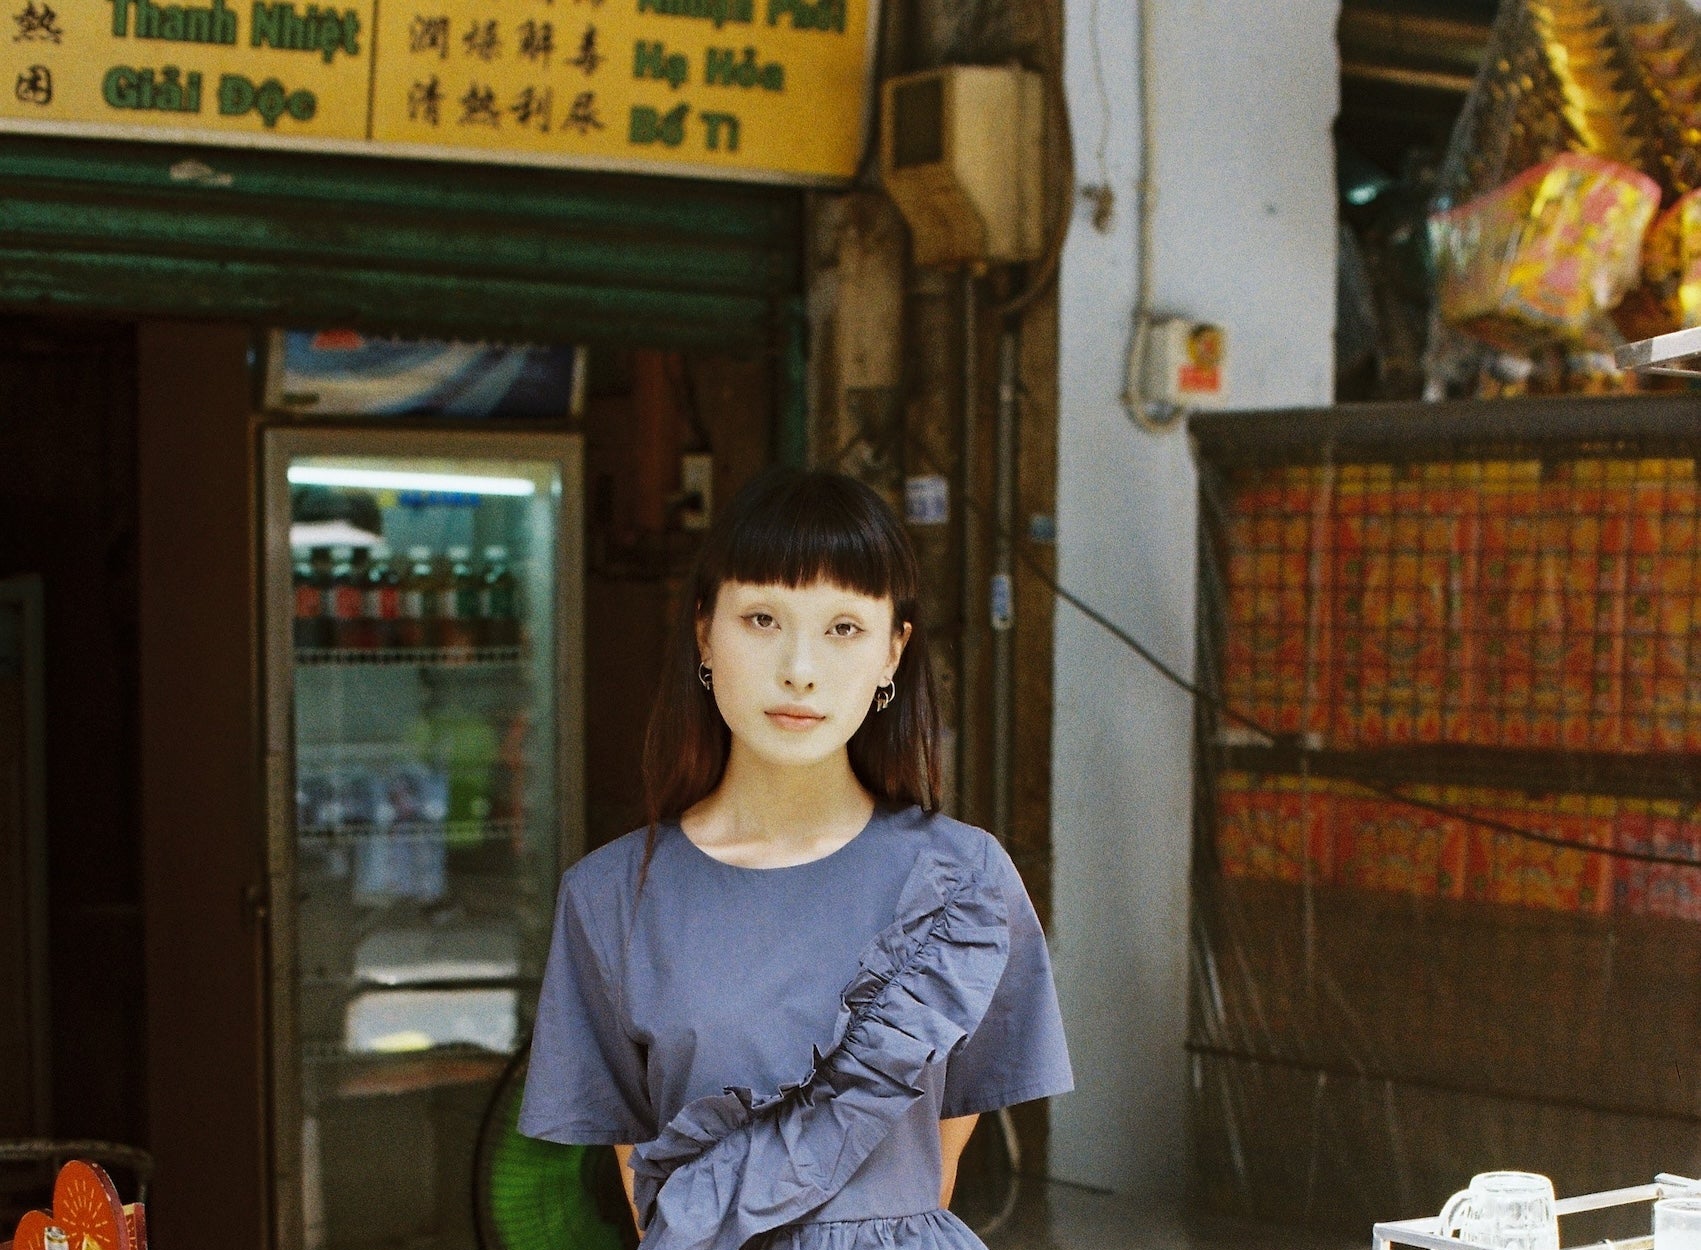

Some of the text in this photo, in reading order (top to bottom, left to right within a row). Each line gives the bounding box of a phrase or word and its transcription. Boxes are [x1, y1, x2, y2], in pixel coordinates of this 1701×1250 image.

[108, 0, 362, 64] Thanh Nhiệt
[102, 64, 203, 113] Giải
